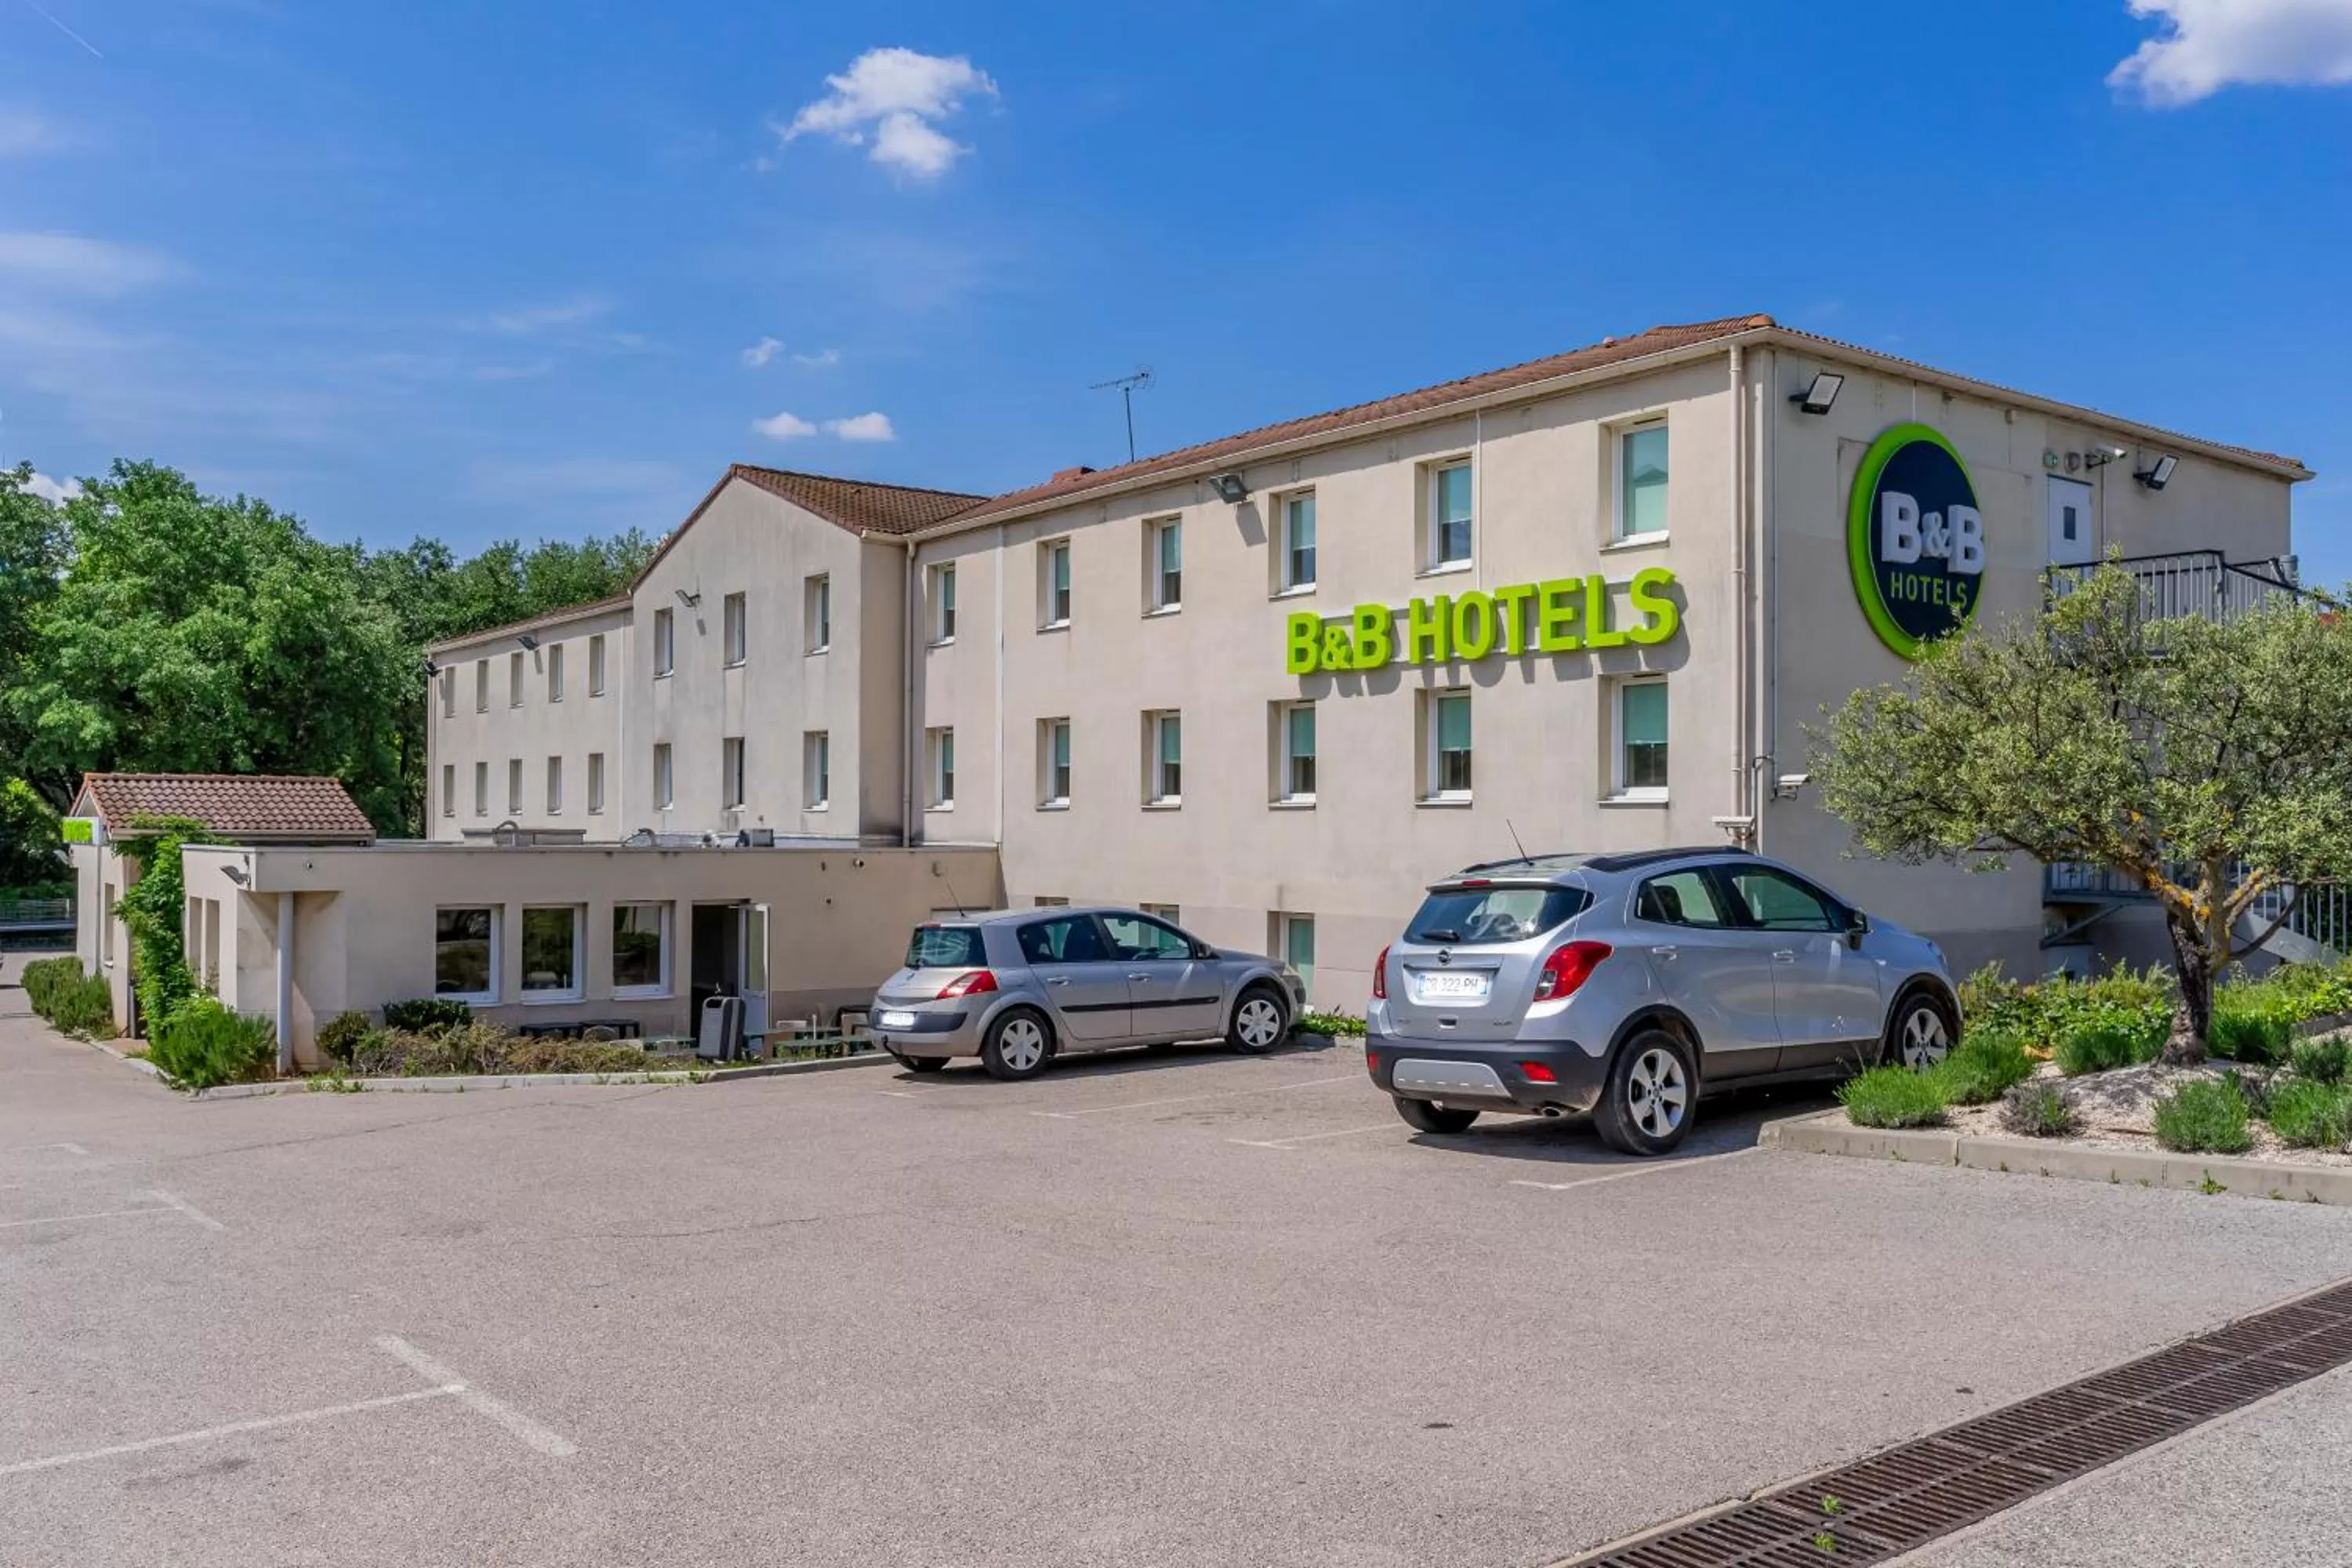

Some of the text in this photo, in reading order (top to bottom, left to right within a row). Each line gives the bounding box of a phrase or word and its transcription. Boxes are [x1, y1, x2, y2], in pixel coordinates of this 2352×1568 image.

[1881, 491, 1985, 574] B&B
[1287, 567, 1679, 674] B&B HOTELS
[1890, 571, 1967, 607] HOTELS
